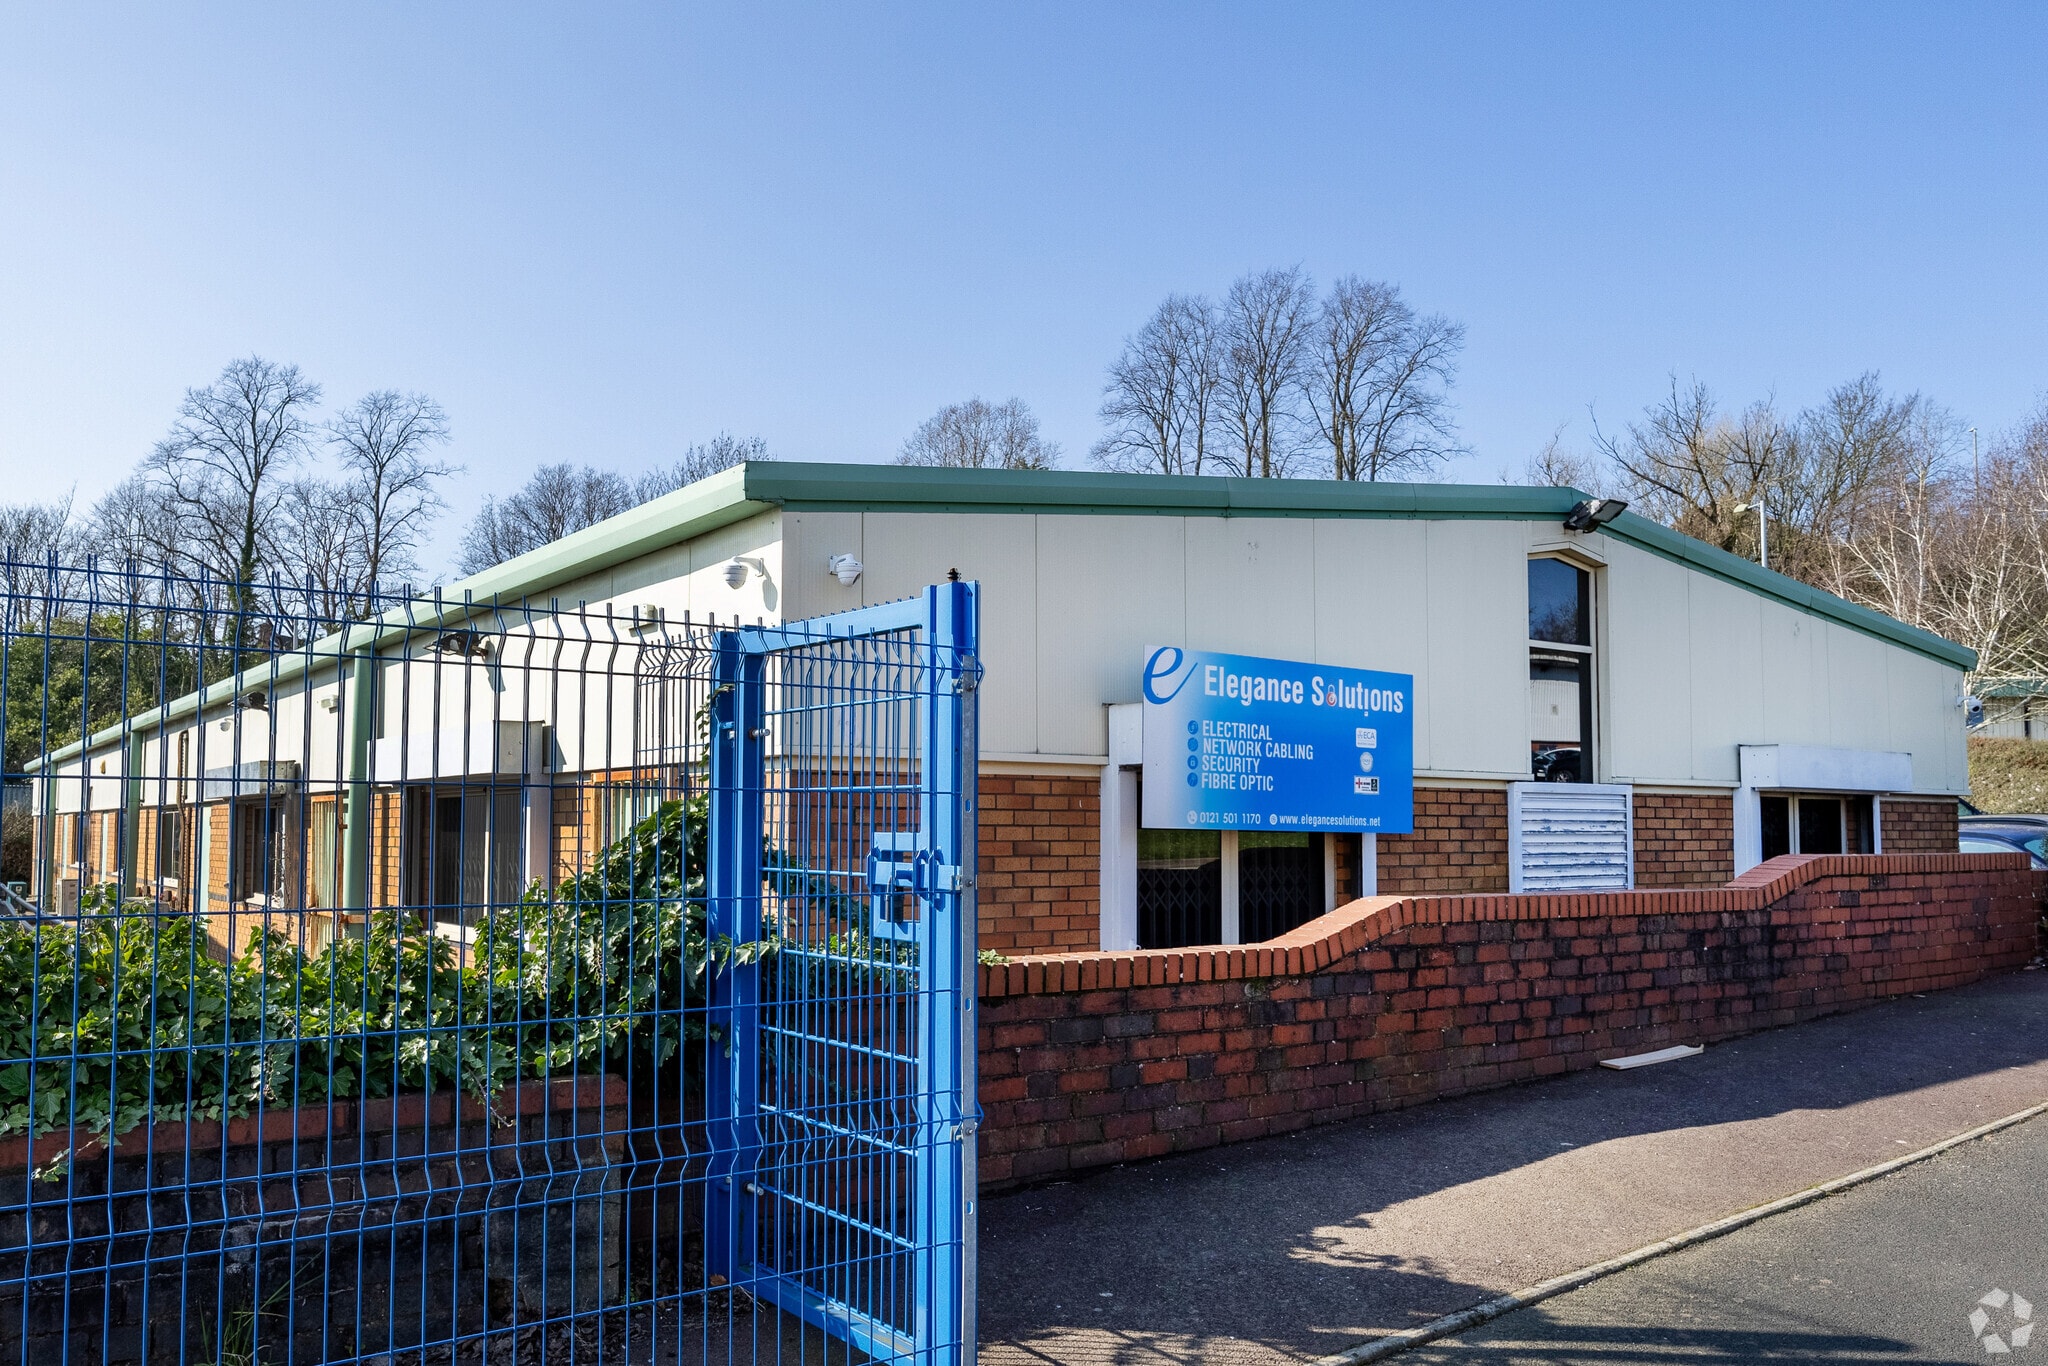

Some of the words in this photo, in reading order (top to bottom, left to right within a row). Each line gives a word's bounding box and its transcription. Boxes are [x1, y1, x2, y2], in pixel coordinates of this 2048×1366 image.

[1204, 664, 1304, 706] Elegance
[1202, 720, 1272, 741] ELECTRICAL
[1363, 731, 1375, 740] ECA
[1203, 740, 1262, 757] NETWORK
[1265, 743, 1314, 760] CABLING
[1202, 755, 1260, 773] SECURITY
[1201, 773, 1236, 790] FIBRE
[1240, 775, 1274, 791] OPTIC
[1200, 811, 1220, 824] 0121
[1223, 812, 1239, 825] 501
[1243, 812, 1261, 825] 1170
[1279, 813, 1381, 828] www.elegancesolutions.net
